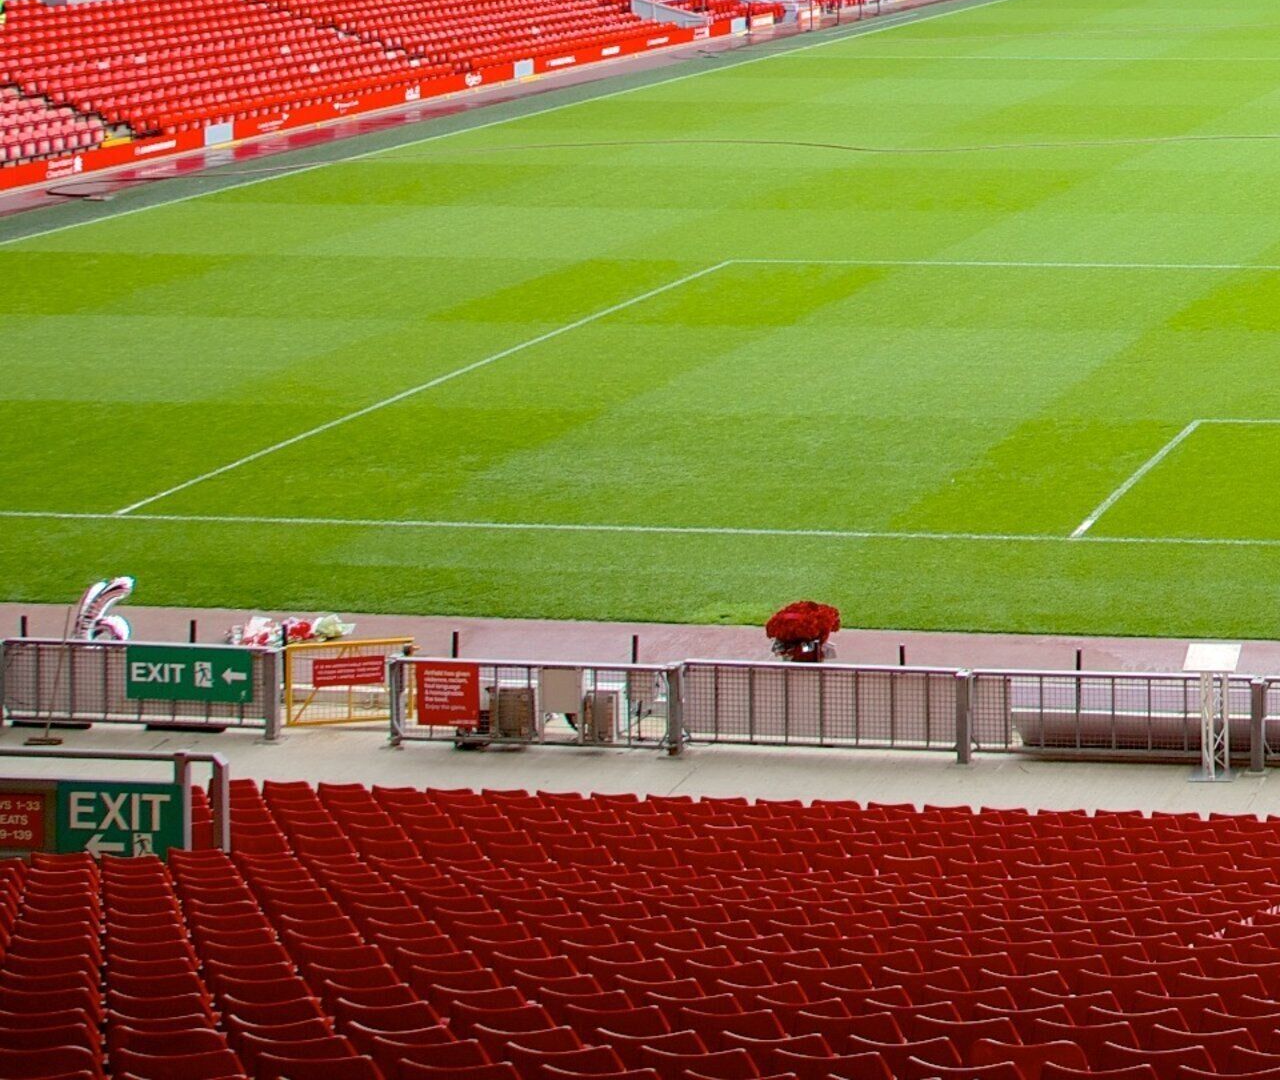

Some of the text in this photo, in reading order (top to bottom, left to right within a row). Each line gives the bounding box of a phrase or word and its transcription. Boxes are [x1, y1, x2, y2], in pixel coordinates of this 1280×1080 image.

[131, 662, 186, 684] EXIT
[16, 801, 41, 811] 1-33
[69, 791, 171, 831] EXIT
